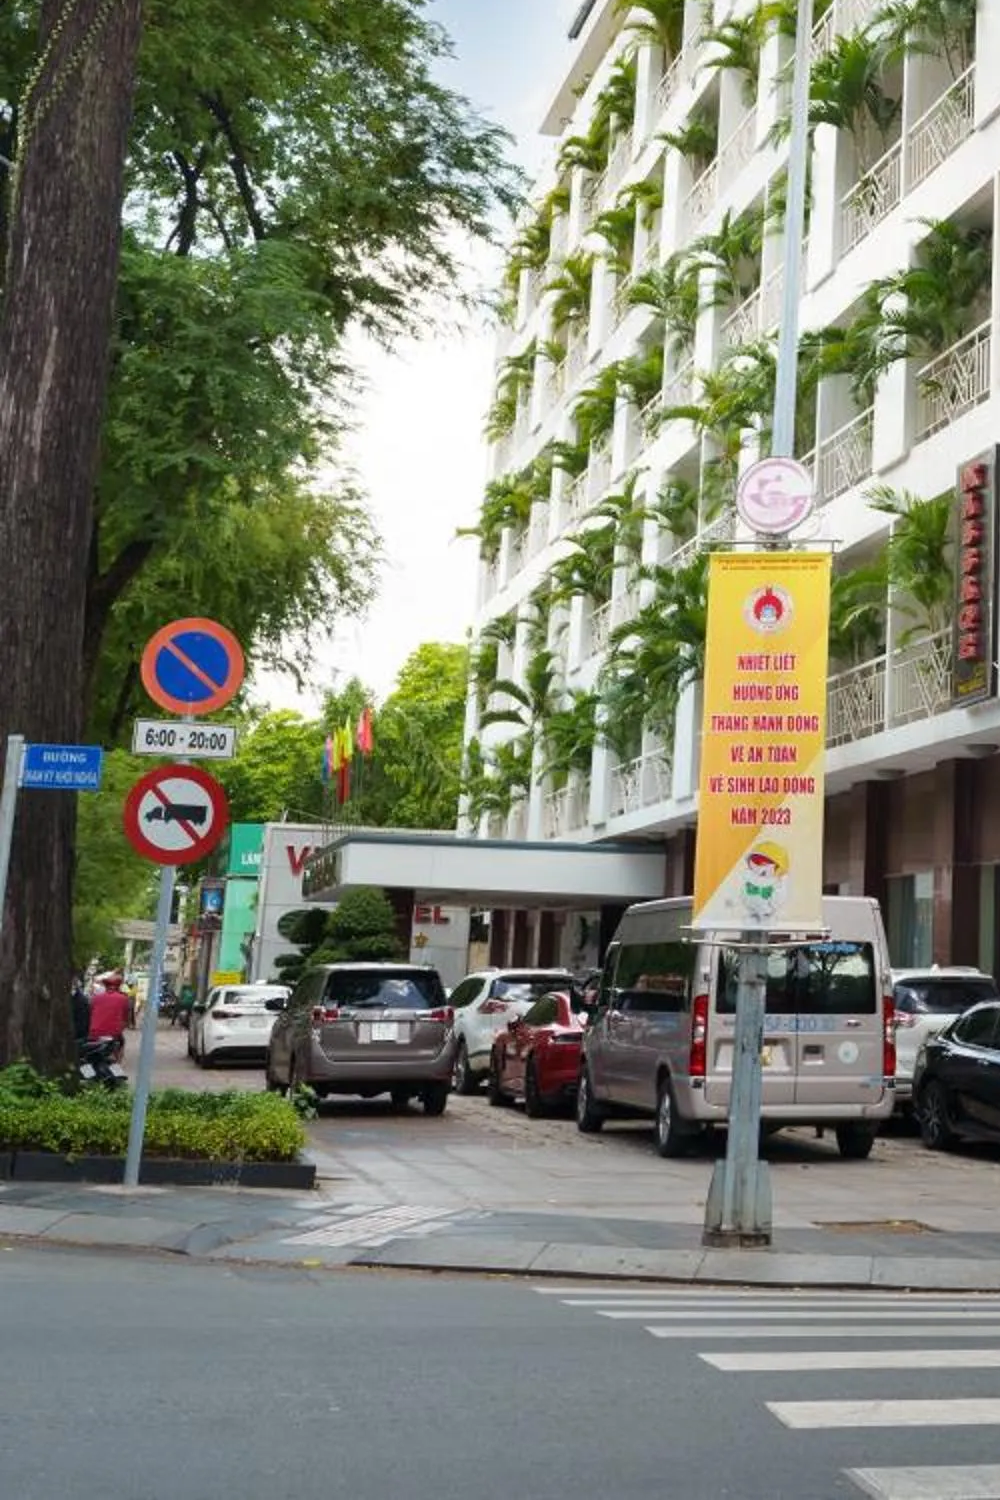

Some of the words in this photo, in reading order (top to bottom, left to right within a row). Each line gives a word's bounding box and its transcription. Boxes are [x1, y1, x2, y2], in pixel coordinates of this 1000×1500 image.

[145, 728, 176, 746] 6:00
[188, 731, 226, 750] 20:00
[761, 807, 791, 825] 2023
